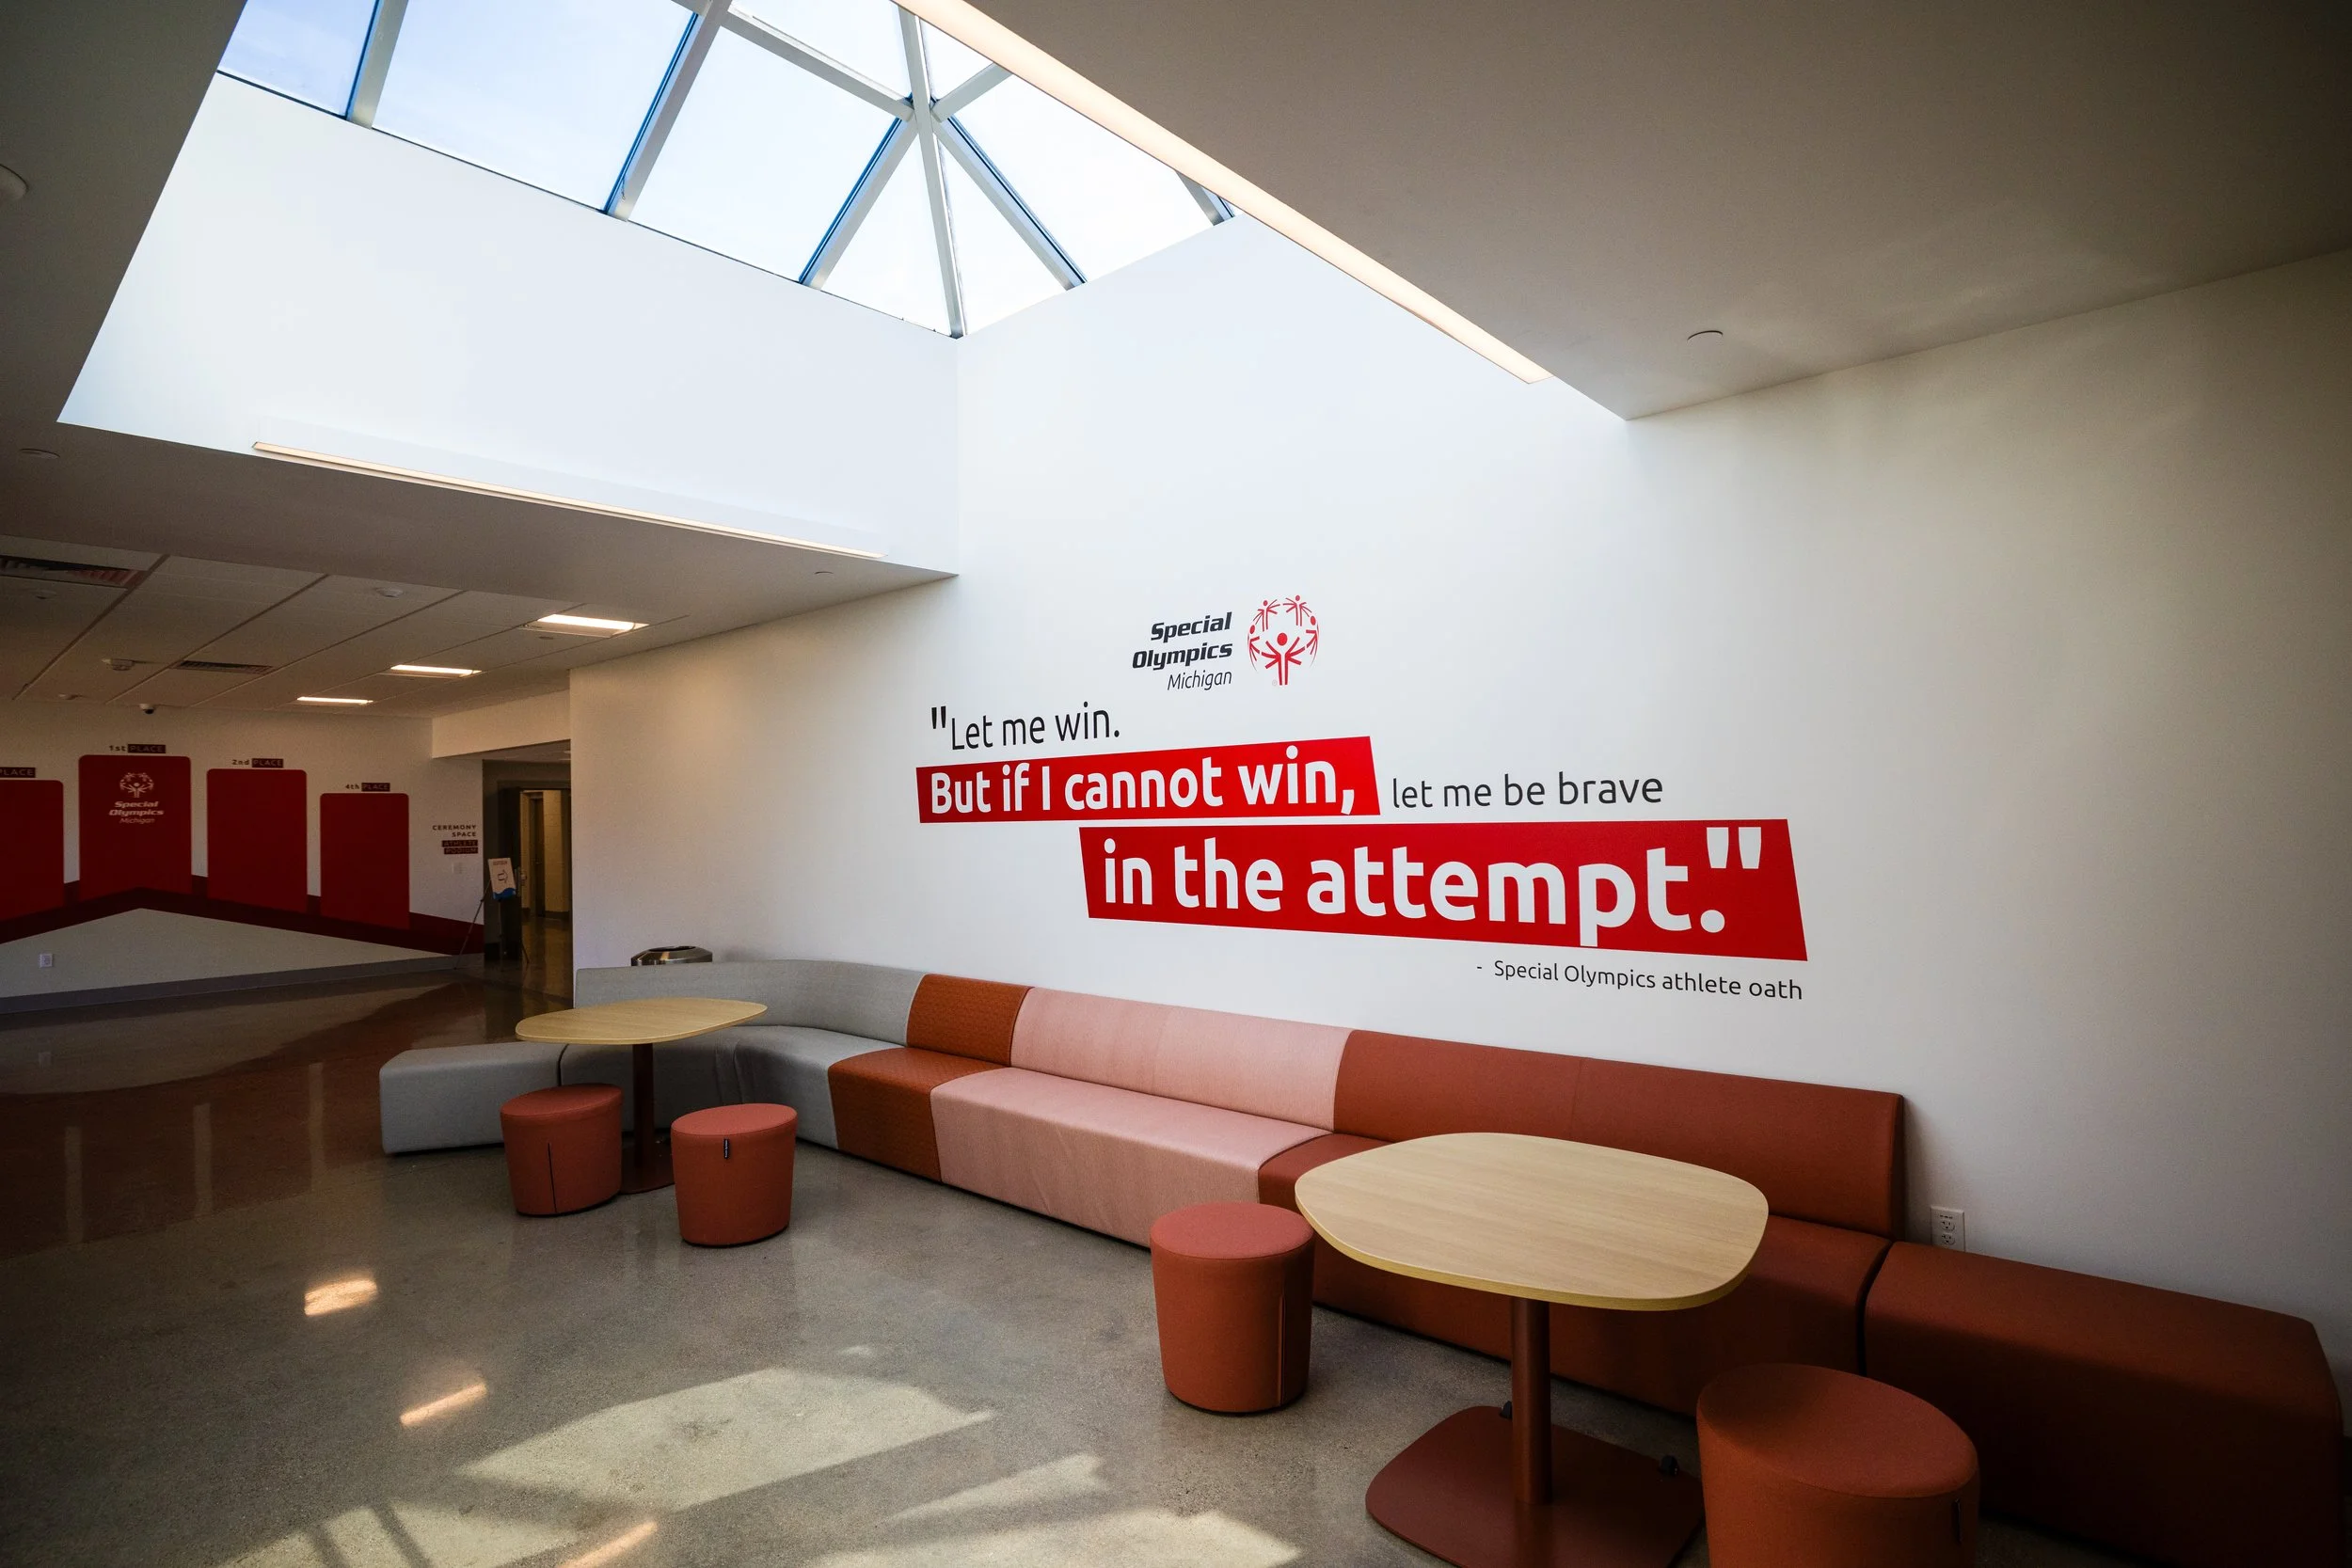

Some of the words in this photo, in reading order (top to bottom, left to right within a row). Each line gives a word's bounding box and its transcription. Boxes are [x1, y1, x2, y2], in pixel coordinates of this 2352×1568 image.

[1151, 611, 1232, 643] Special
[1132, 641, 1233, 672] Olympics
[1167, 669, 1232, 691] Michigan
[930, 705, 993, 752] "Let
[1002, 714, 1046, 746] me
[1055, 701, 1120, 743] win.
[930, 769, 992, 815] But
[1001, 762, 1030, 812] if
[1041, 765, 1051, 812] I
[1064, 756, 1224, 811] cannot
[1237, 745, 1356, 816] win,
[1392, 778, 1433, 809] let
[1442, 781, 1492, 808] me
[1504, 773, 1546, 806] be
[1558, 771, 1663, 805] brave
[108, 809, 165, 817] Olympics
[1103, 838, 1153, 906] in
[1173, 836, 1284, 913] the
[1306, 826, 1763, 947] attempt."
[1493, 959, 1559, 982] Special
[1564, 964, 1657, 990] Olympics
[1661, 973, 1741, 997] athlete
[1748, 978, 1804, 1001] oath
